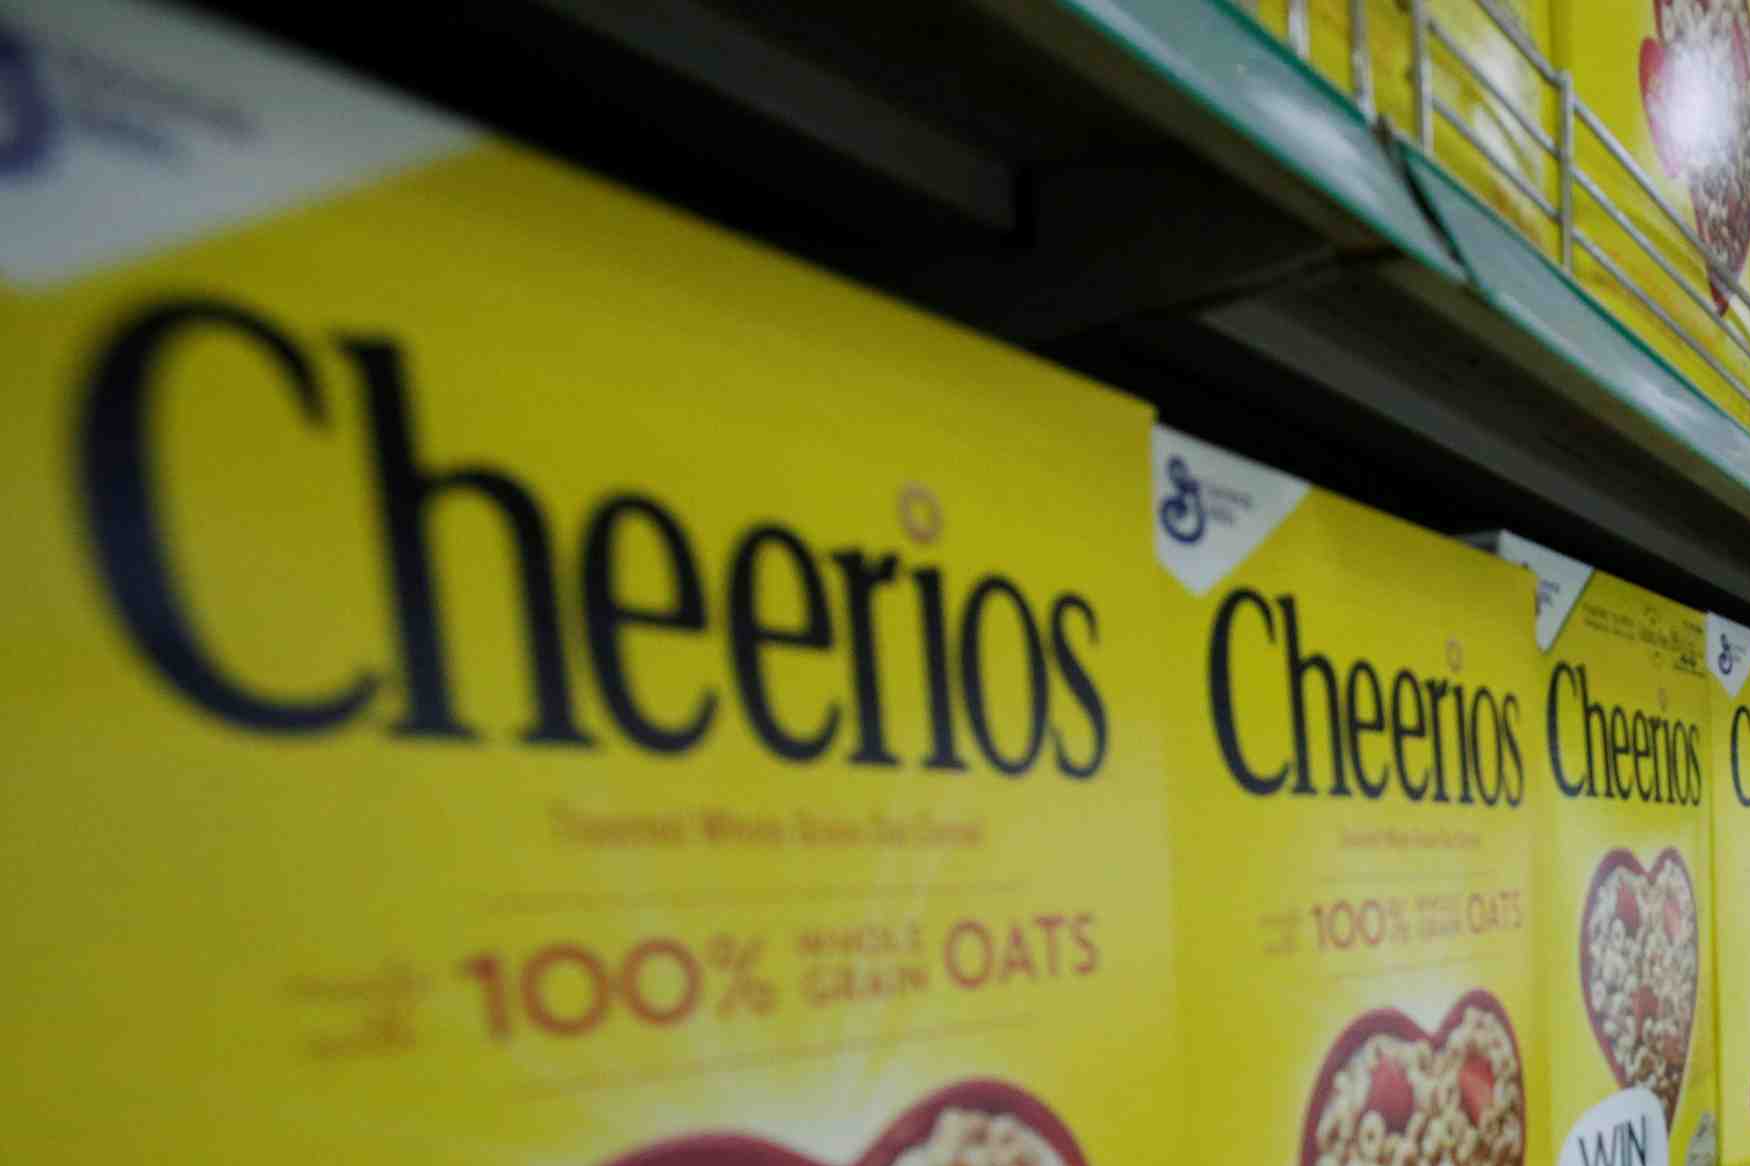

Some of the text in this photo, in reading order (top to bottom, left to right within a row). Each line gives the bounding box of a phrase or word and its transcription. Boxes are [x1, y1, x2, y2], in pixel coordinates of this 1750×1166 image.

[70, 294, 1108, 778] Cheerios
[1207, 588, 1524, 808] Cheerios
[1547, 661, 1700, 807] Cheerios
[458, 932, 778, 1043] 100%
[943, 913, 1098, 990] OATS
